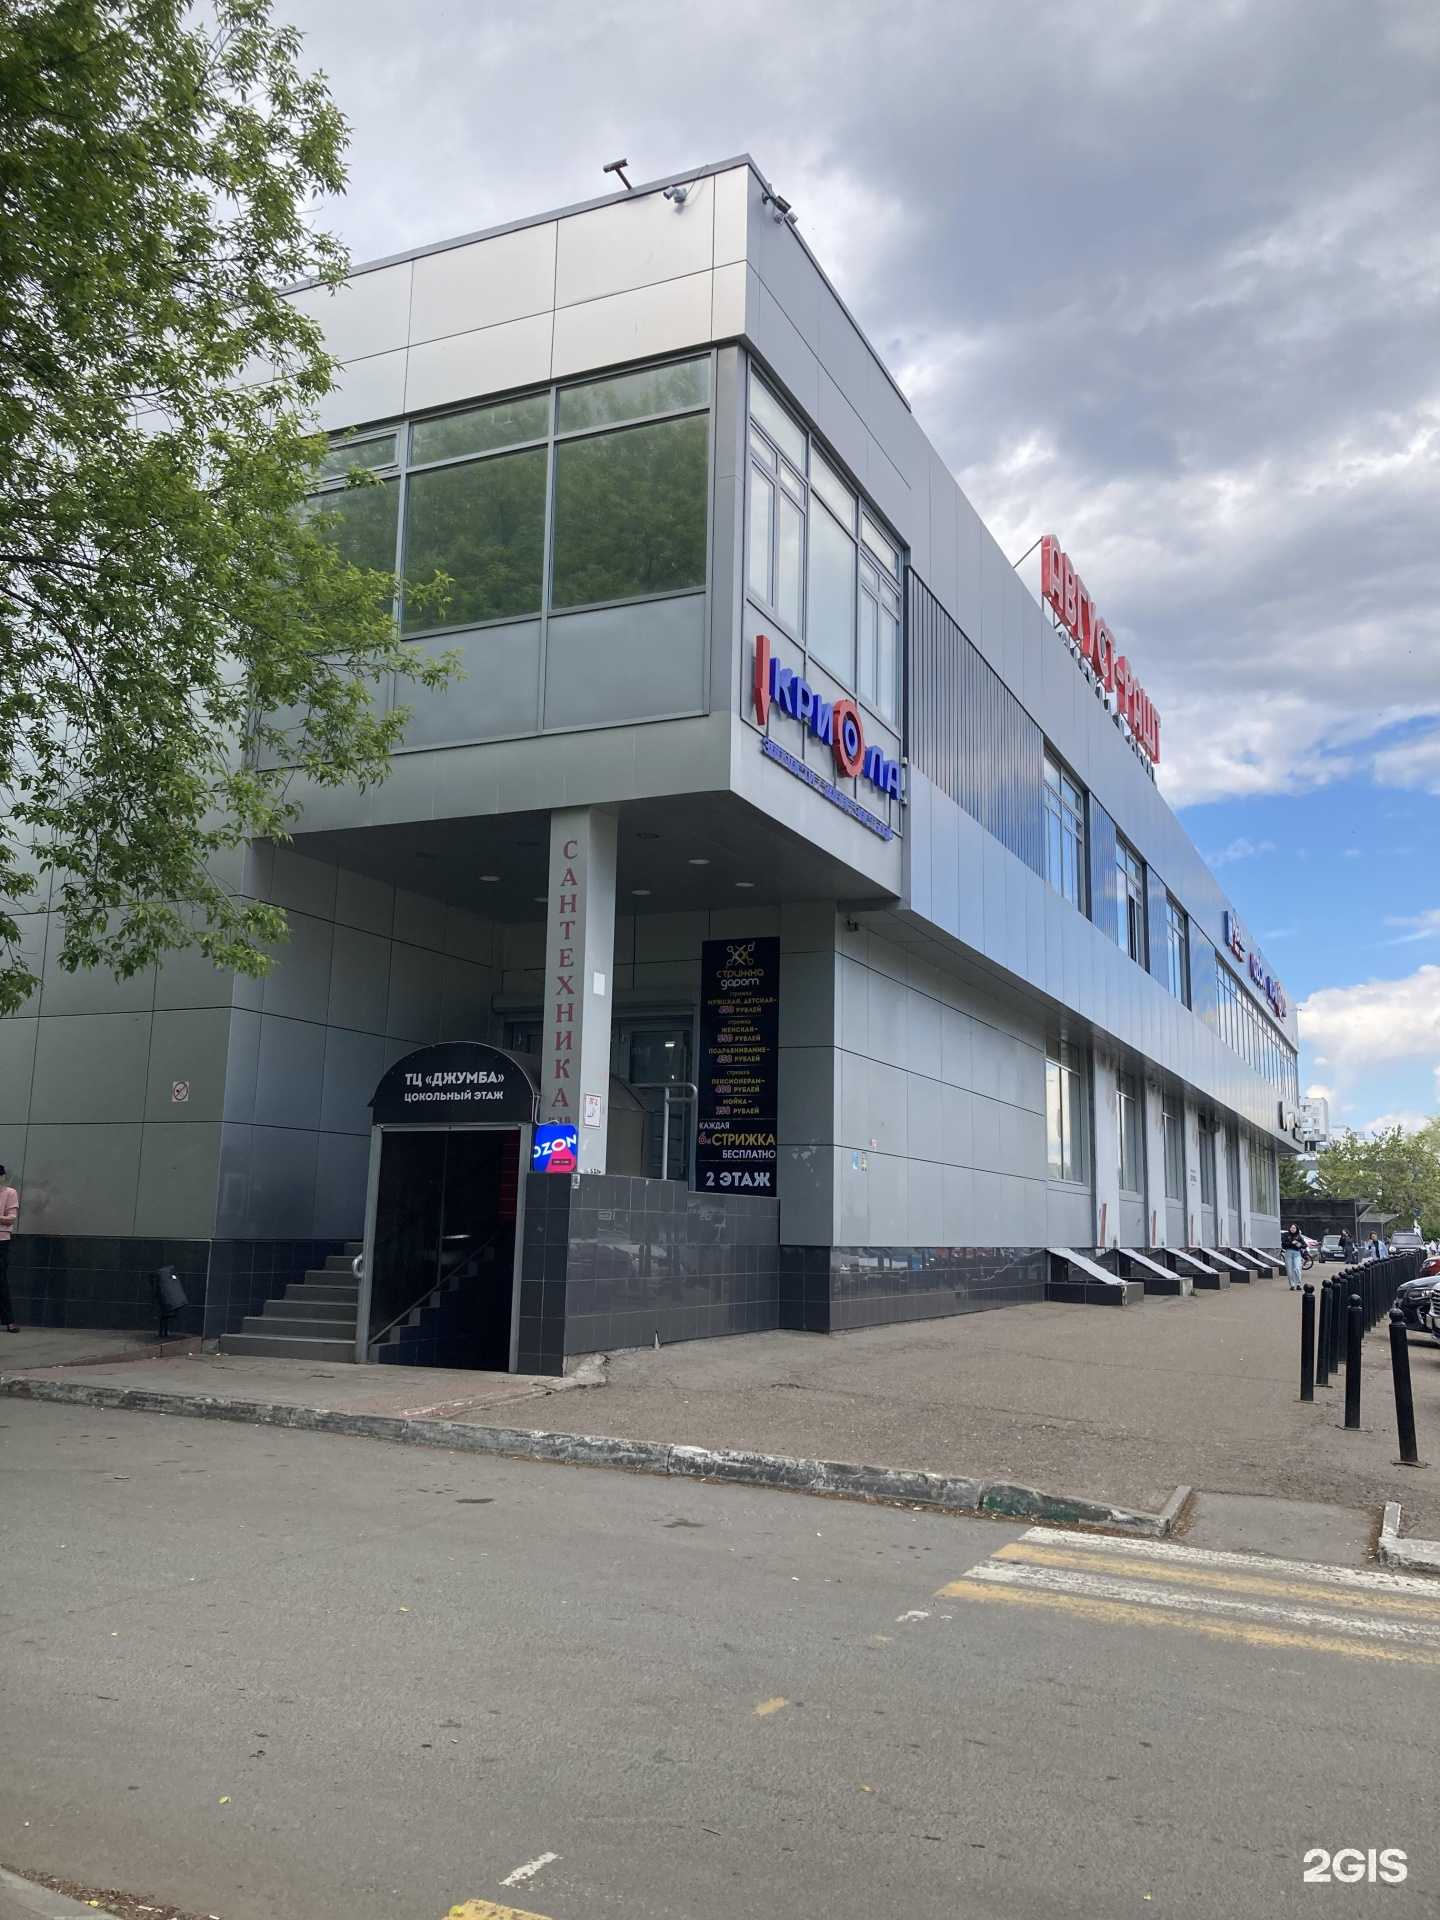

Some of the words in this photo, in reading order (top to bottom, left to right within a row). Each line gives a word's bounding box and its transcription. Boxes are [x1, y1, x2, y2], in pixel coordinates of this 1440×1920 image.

[551, 839, 579, 1108] САНТЕХНИКА
[405, 1073, 423, 1087] ТЦ
[425, 1071, 505, 1087] «ДЖУМБА»
[404, 1089, 472, 1103] ЦОКОЛЬНЫЙ
[473, 1091, 504, 1100] ЭТАЖ
[698, 1121, 730, 1129] КАЖДАЯ
[711, 1133, 776, 1146] СТРИЖКА
[722, 1149, 776, 1159] БЕСПЛАТНО
[705, 1171, 715, 1186] 2
[719, 1171, 771, 1187] ЭТАЖ
